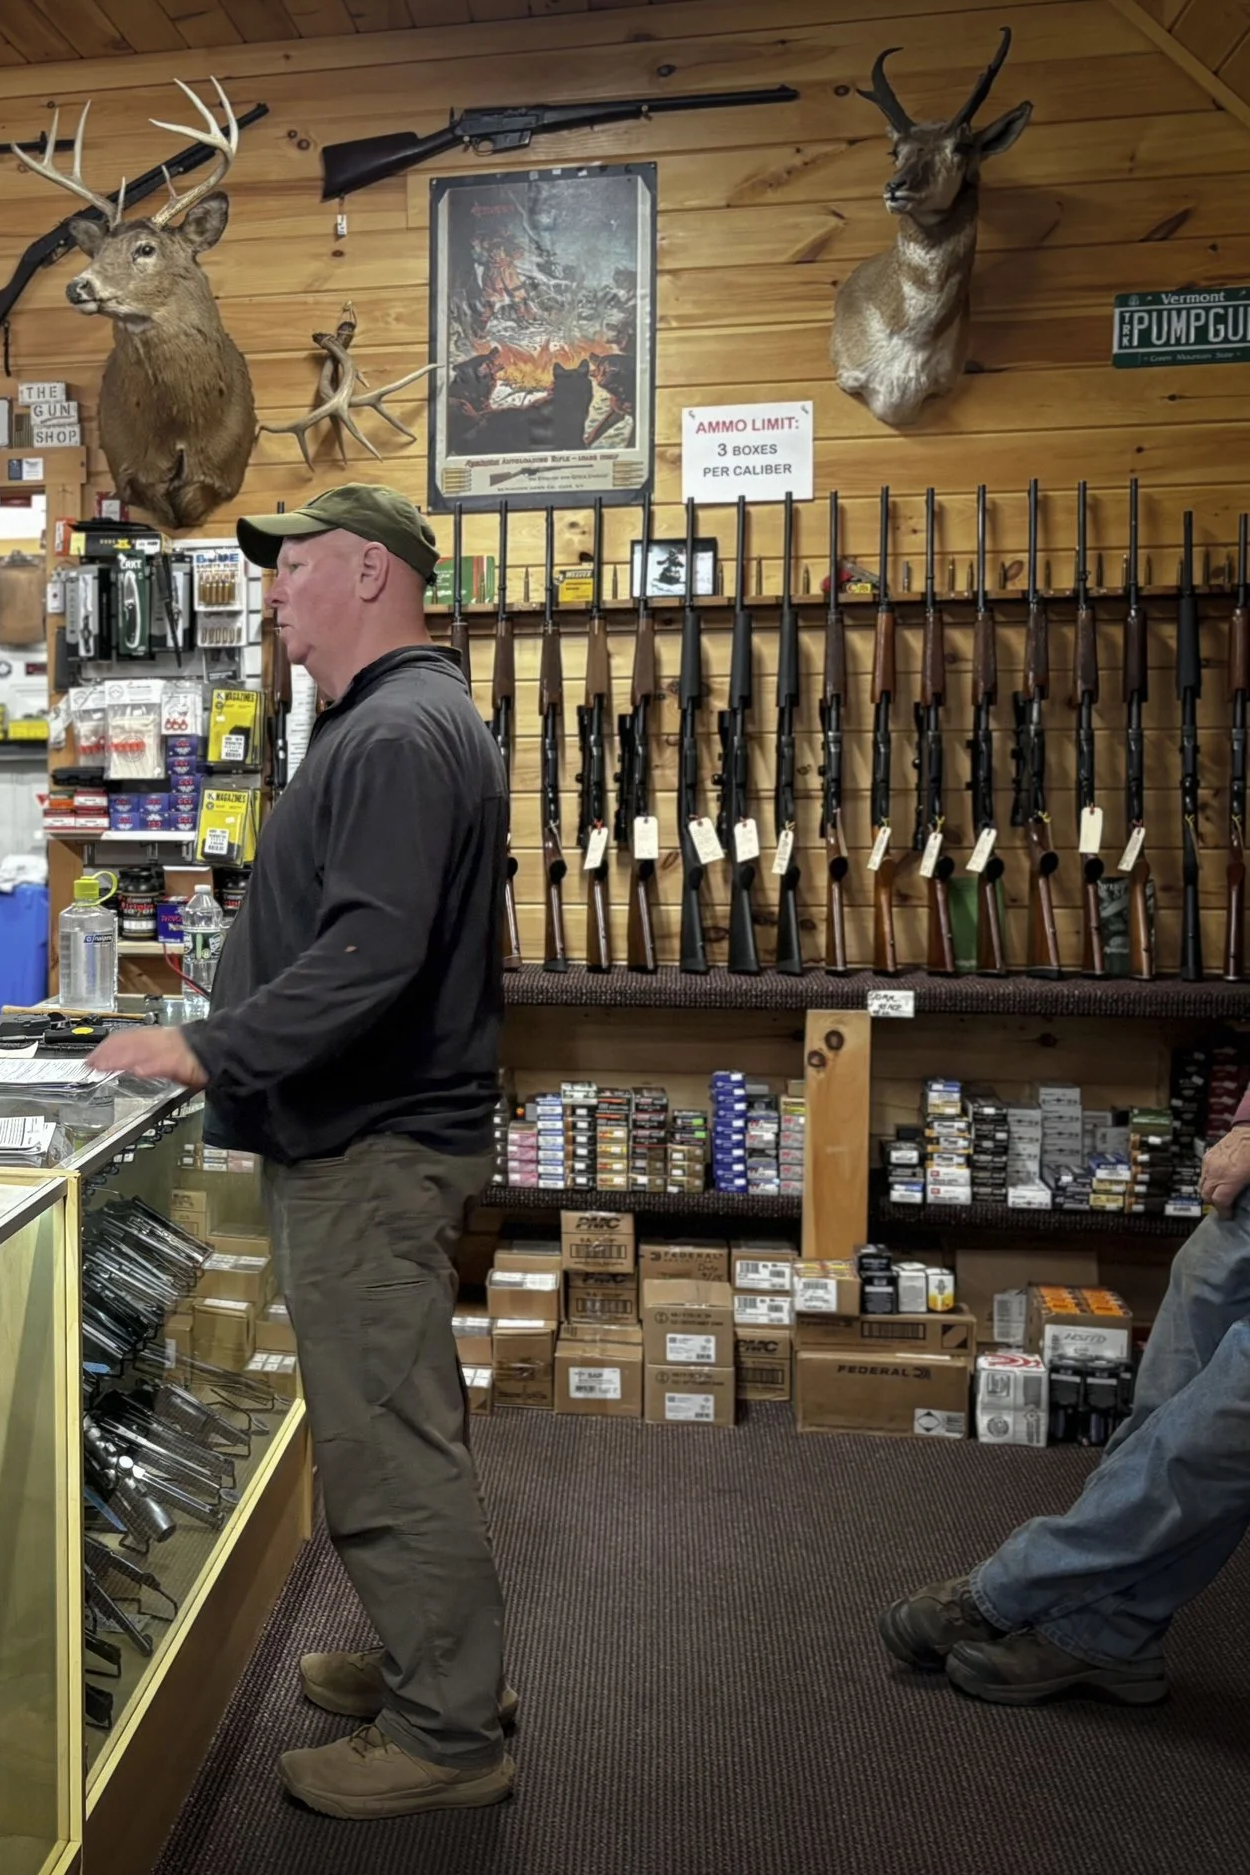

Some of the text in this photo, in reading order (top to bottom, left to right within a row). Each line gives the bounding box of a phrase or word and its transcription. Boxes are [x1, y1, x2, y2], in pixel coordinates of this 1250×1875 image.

[1161, 291, 1226, 304] Vermont
[26, 386, 57, 399] THE
[34, 403, 70, 417] GUN
[695, 416, 799, 434] AMMO LIMIT:
[36, 430, 77, 443] SHOP
[717, 443, 778, 457] 3 BOXES
[703, 463, 792, 477] PER CALIBER
[574, 1215, 623, 1231] PMC
[836, 1364, 910, 1378] FEDERAL
